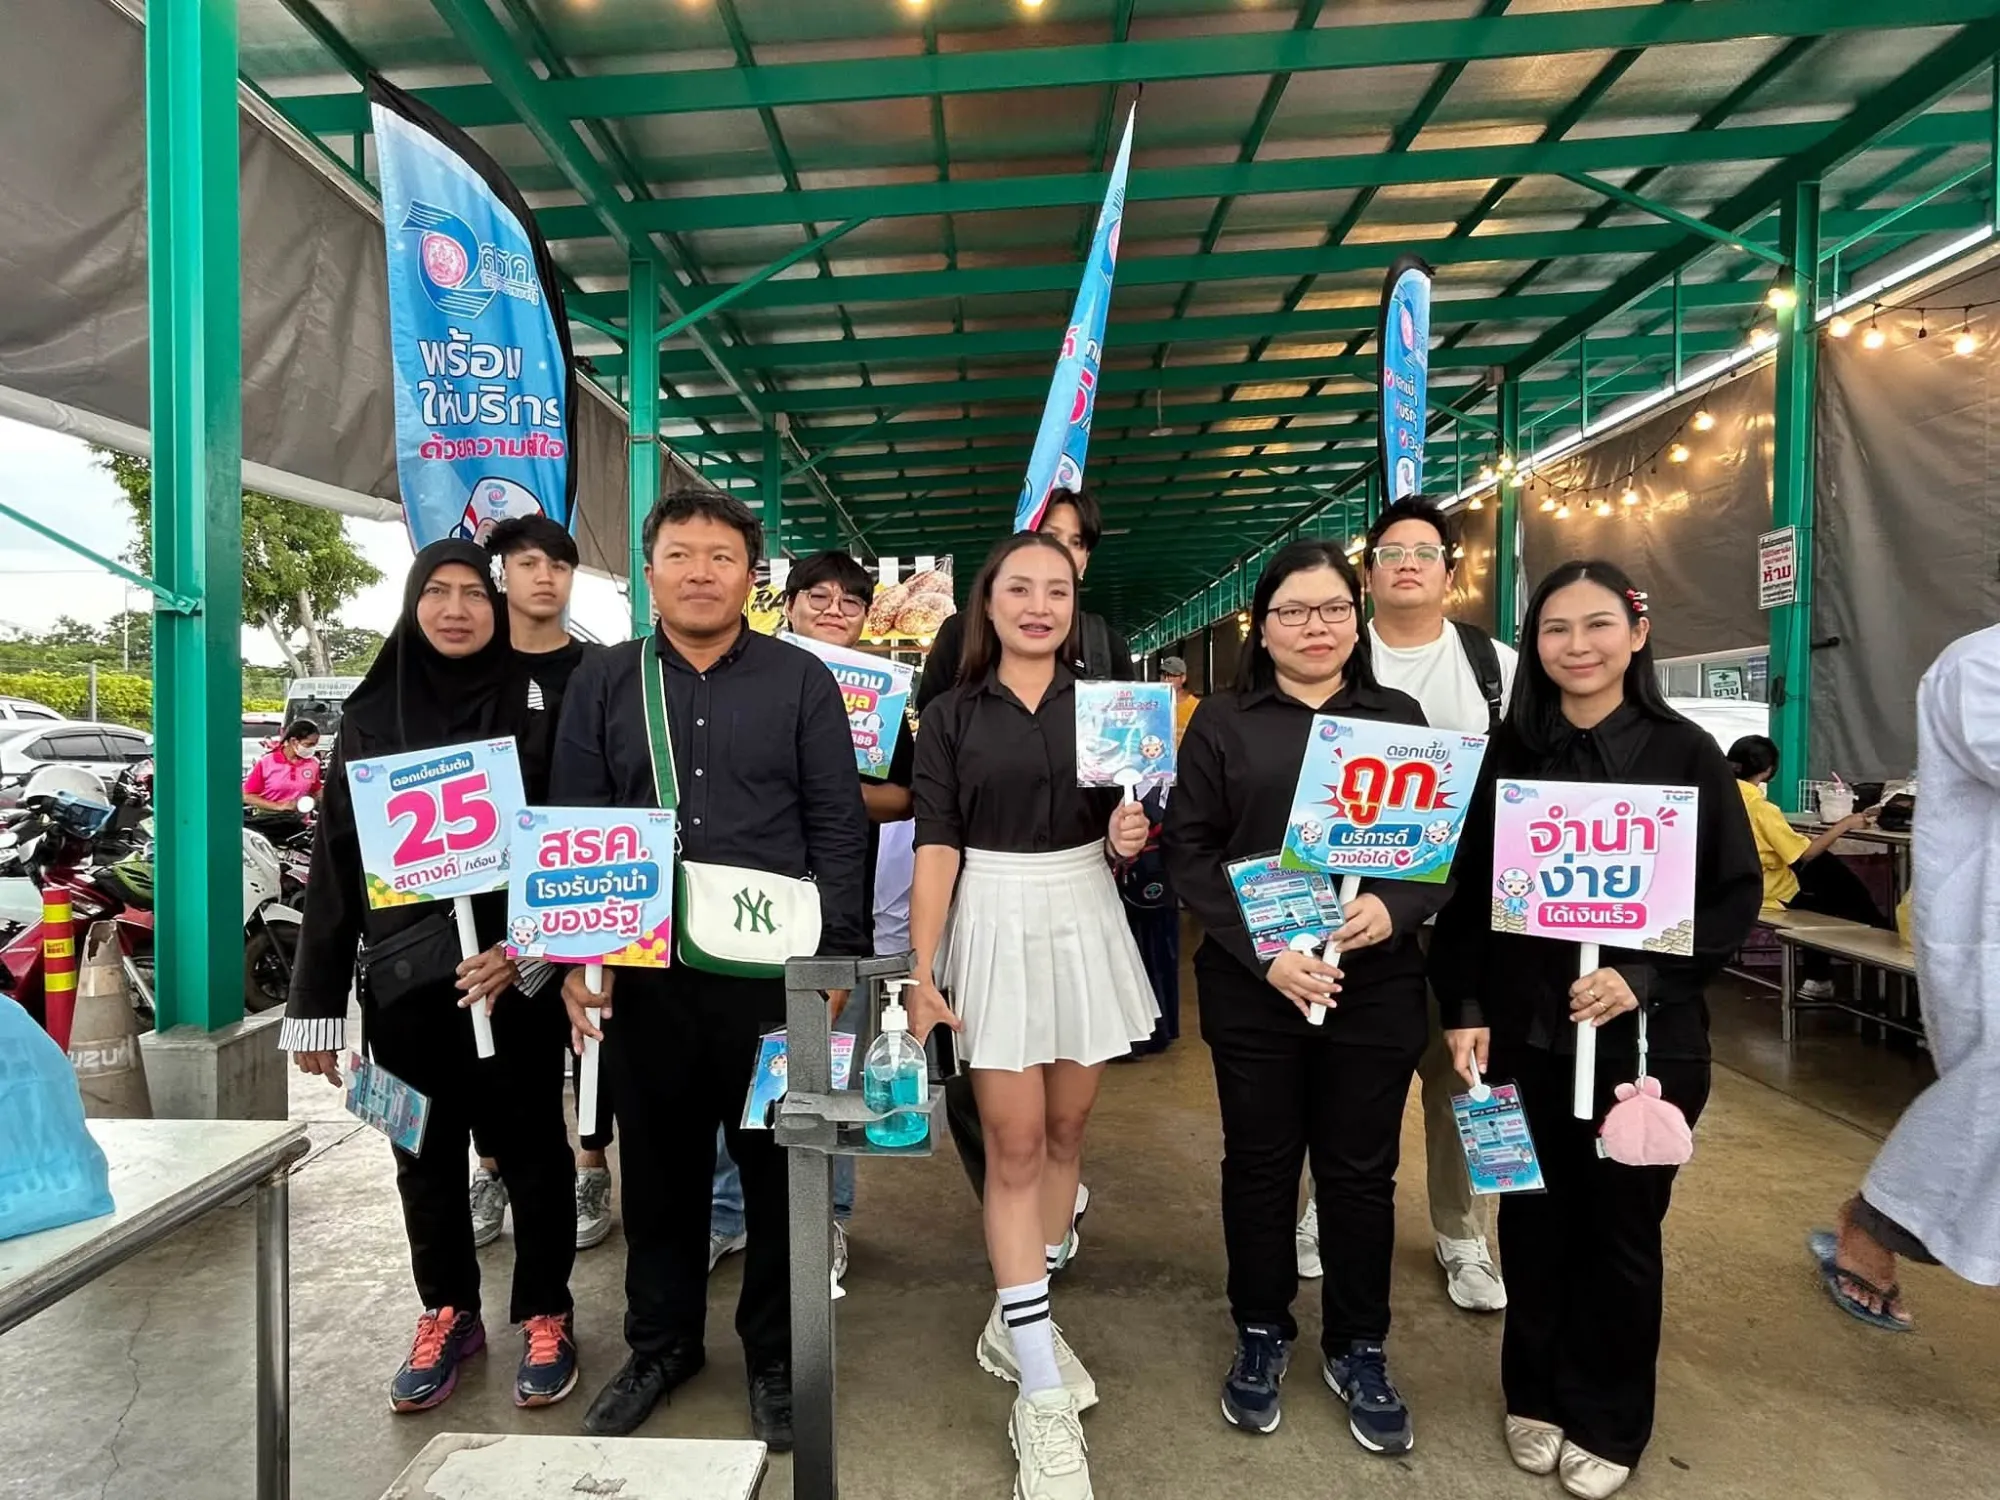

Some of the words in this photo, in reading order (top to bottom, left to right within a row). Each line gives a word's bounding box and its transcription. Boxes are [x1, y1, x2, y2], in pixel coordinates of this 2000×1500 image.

[1386, 741, 1446, 761] ดอกเบี้ย
[392, 758, 471, 787] ดอกเบี้ยเริ่มต้น
[1341, 757, 1437, 826] ถูก
[386, 772, 498, 868] 25
[1341, 829, 1410, 845] บริการดี
[1529, 801, 1656, 854] จำนำ
[539, 825, 648, 868] สธค.
[1329, 848, 1391, 865] วางใจได้
[394, 857, 458, 890] สตางค์
[464, 854, 497, 872] /เดือน
[536, 868, 648, 899] โรงรับจำนำ
[1539, 853, 1642, 899] ง่าย
[541, 899, 640, 935] ของรัฐ
[1545, 905, 1639, 924] ได้เงินเร็ว
